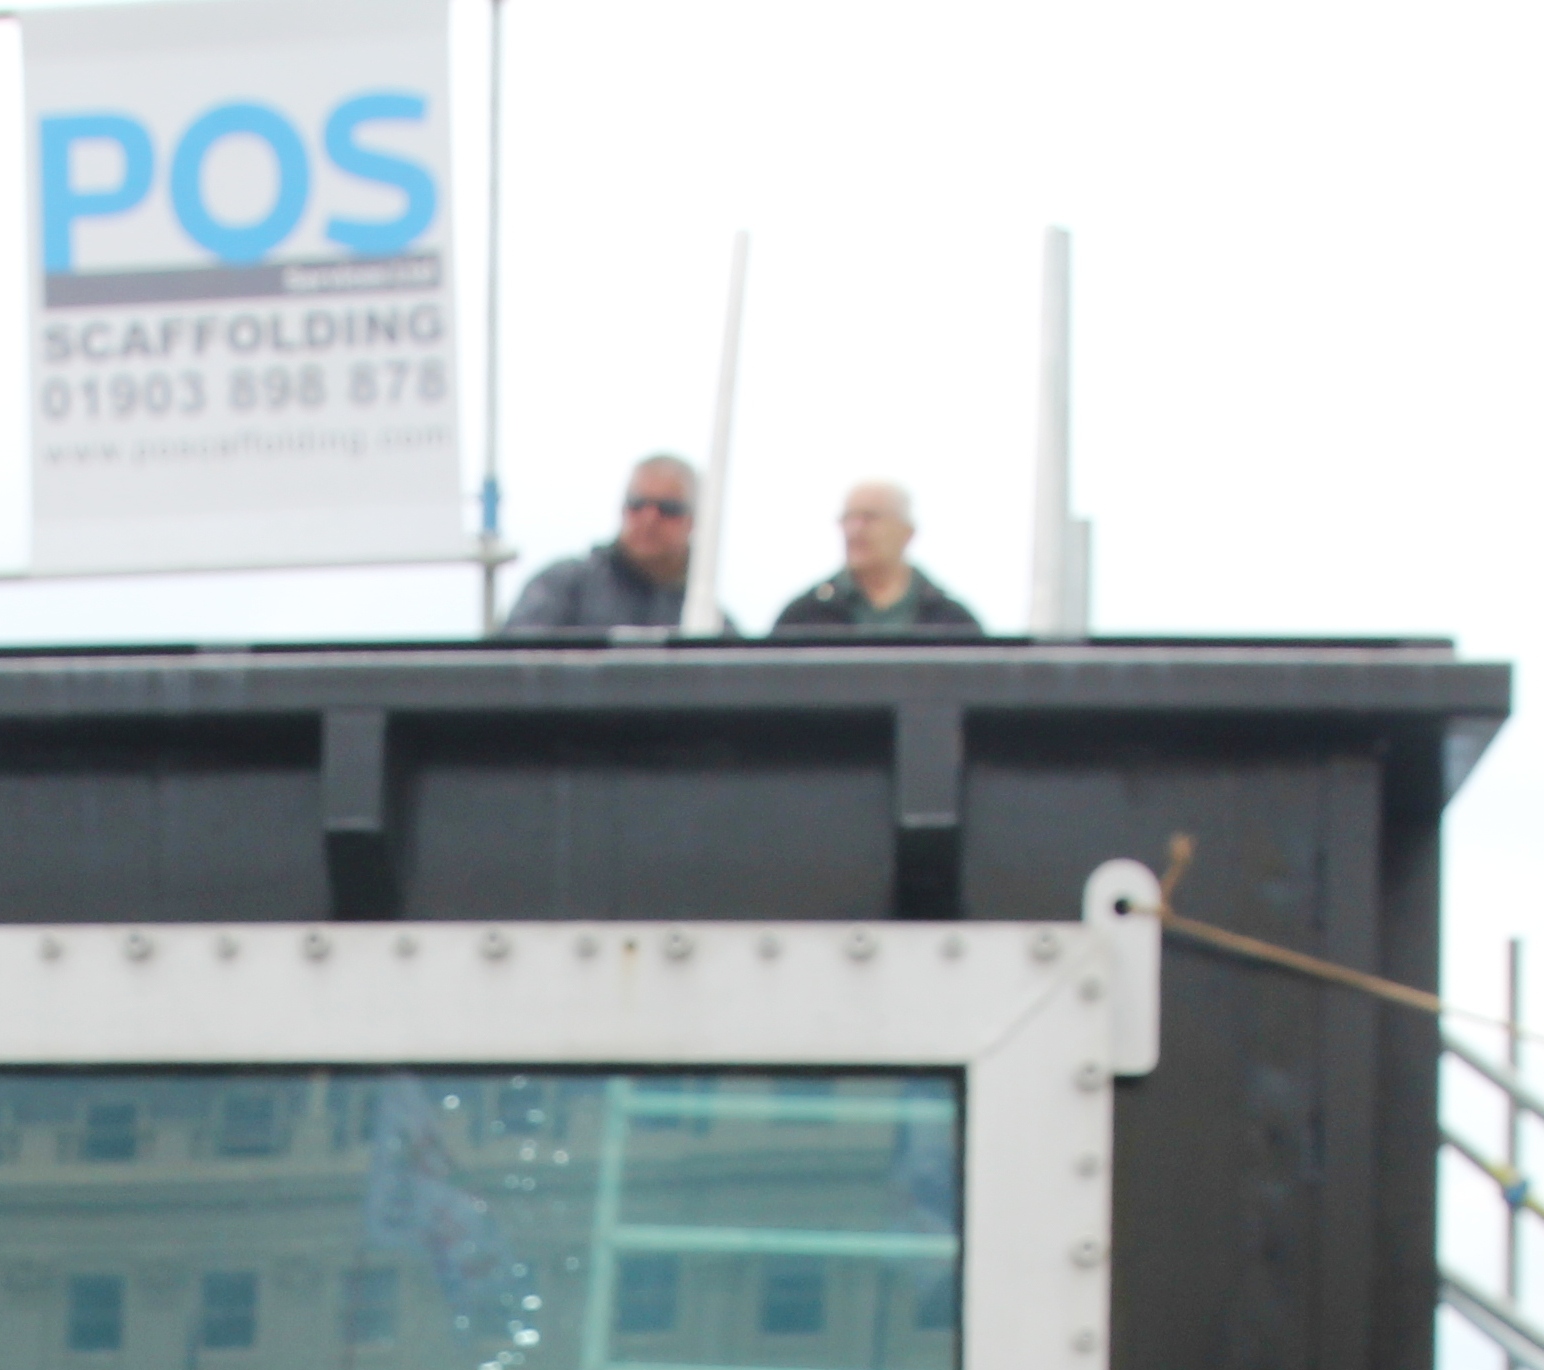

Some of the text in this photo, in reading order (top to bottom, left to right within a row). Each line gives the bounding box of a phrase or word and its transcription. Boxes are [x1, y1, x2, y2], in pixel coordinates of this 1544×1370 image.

[40, 93, 437, 271] POS
[44, 303, 444, 362] SCAFFOLDING
[41, 356, 449, 423] 01903 898 878
